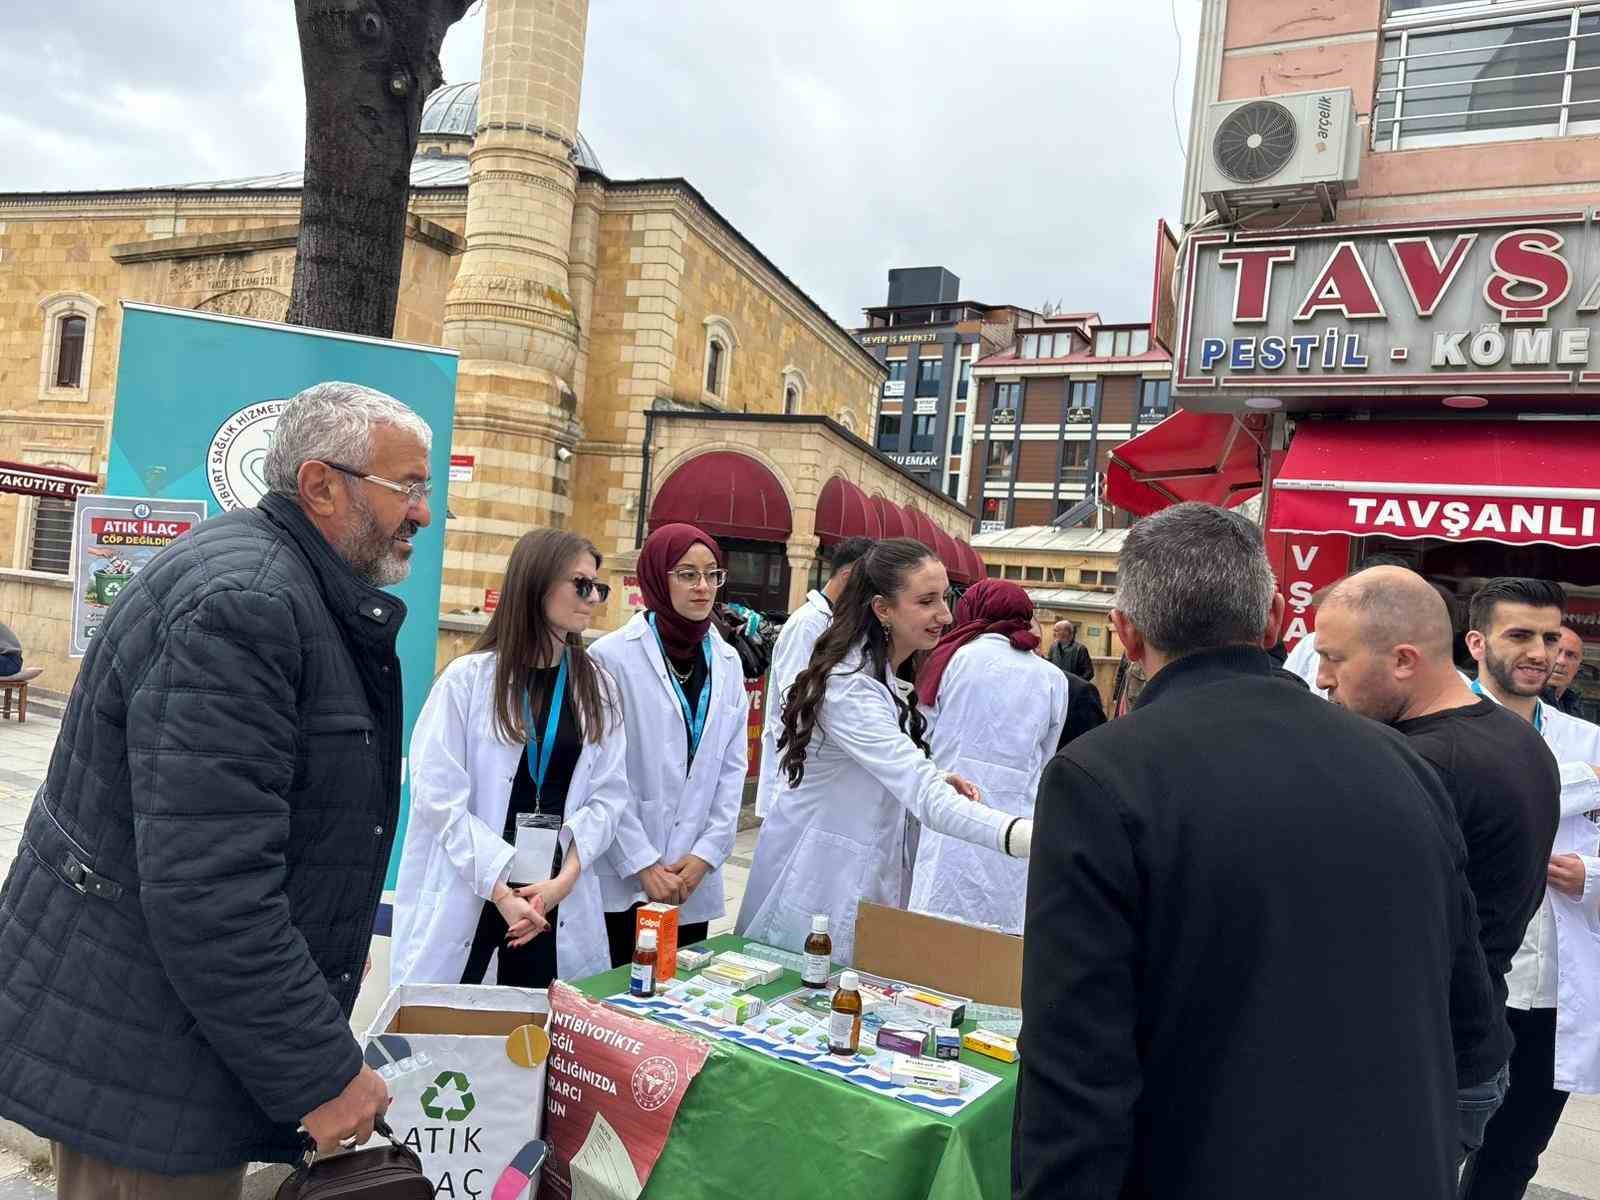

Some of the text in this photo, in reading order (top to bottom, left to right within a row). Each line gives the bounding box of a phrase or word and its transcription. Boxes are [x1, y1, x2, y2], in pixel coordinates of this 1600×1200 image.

[1318, 95, 1333, 139] arçelik
[1200, 327, 1368, 371] PESTİL
[1430, 323, 1591, 367] KÖME
[212, 424, 238, 464] SAĞLIK
[236, 403, 284, 426] HİZMET
[905, 455, 939, 466] EMLAK
[103, 519, 178, 536] ATIK İLAÇ
[1347, 497, 1597, 540] TAVŞANLI
[102, 534, 123, 545] ÇÖP
[551, 1010, 645, 1056] NTİBİYOTİKTE
[552, 1032, 575, 1055] EĞİL
[549, 1053, 618, 1096] AĞLIĞINIZDA
[549, 1076, 582, 1103] RARCI
[547, 1095, 567, 1118] LUN
[403, 1126, 483, 1154] ATIK
[435, 1168, 484, 1200] AÇ
